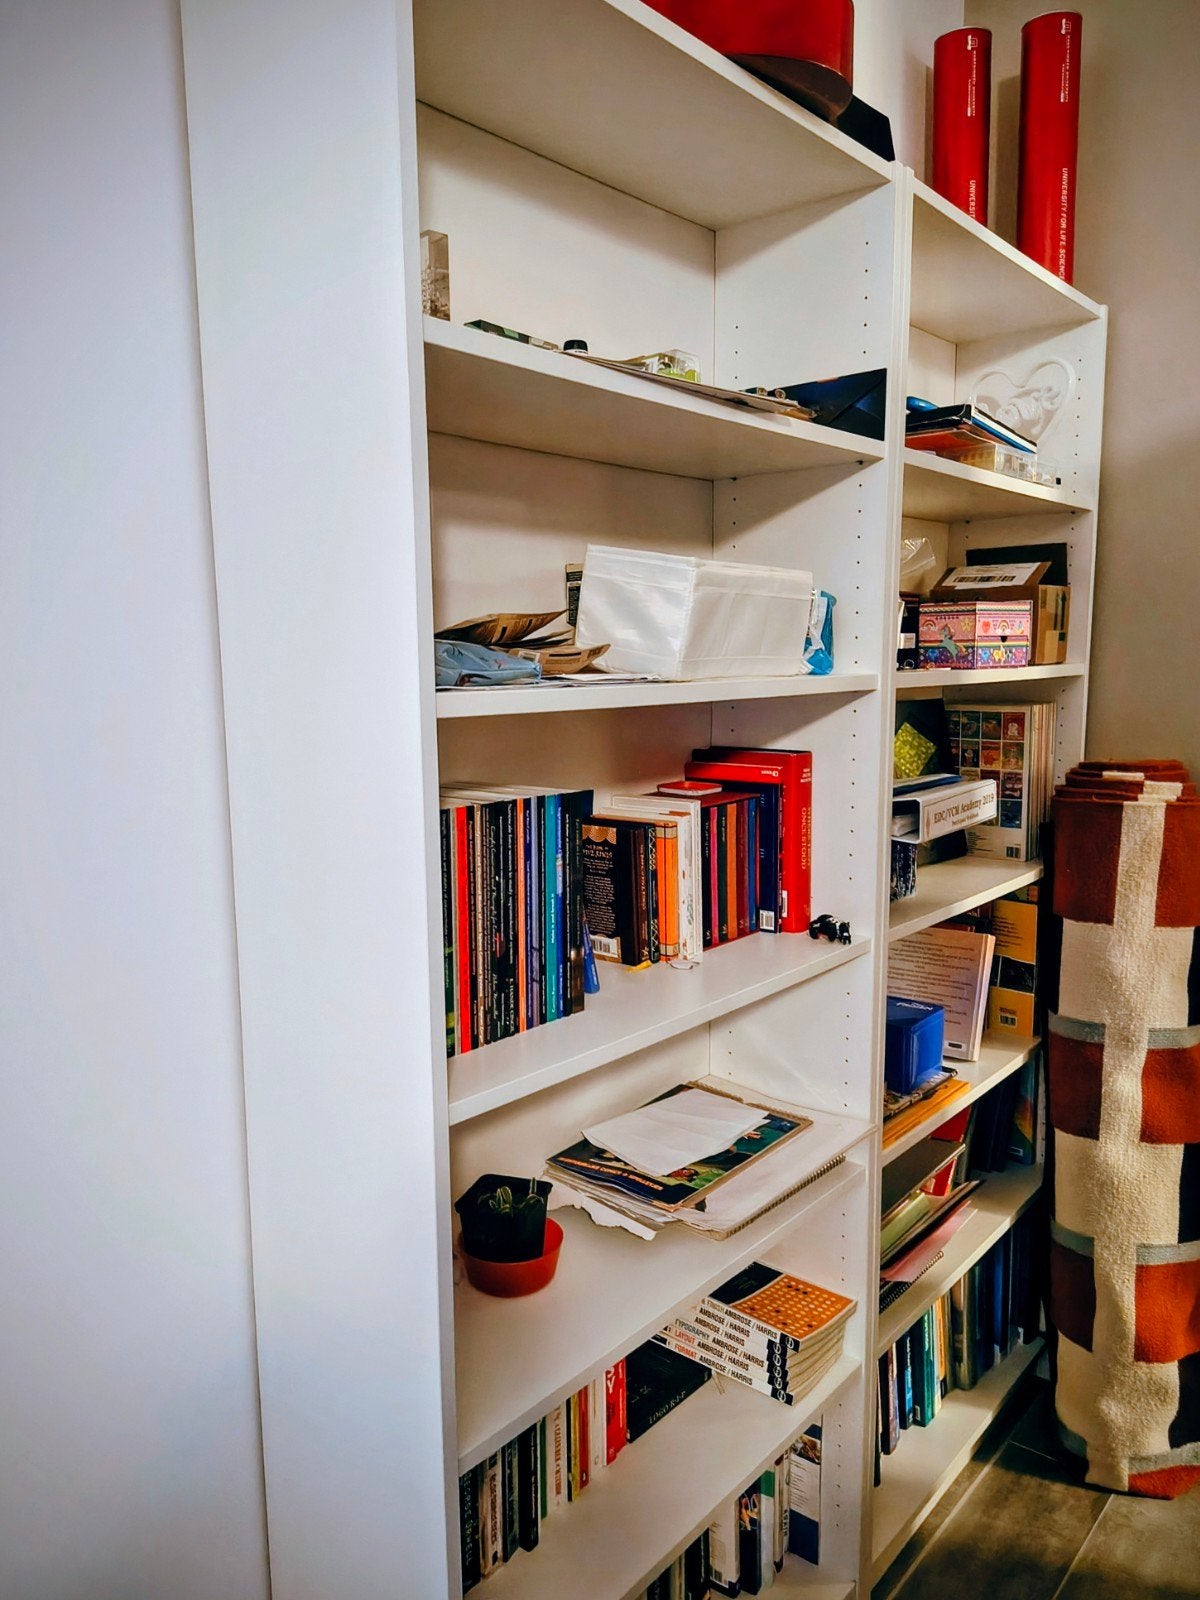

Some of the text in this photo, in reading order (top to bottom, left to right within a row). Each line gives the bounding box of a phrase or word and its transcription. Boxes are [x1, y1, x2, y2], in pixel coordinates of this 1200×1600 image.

[982, 792, 995, 805] 2019
[695, 1317, 720, 1334] AMBROSE
[724, 1330, 745, 1346] HARRIS
[699, 1307, 726, 1325] AMBROSE
[729, 1321, 750, 1337] HARRIS
[725, 1307, 752, 1327] AMBROSE
[756, 1323, 778, 1339] HARRIS
[675, 1319, 710, 1340] TYPOGRAPHY
[712, 1337, 739, 1356] AMBROSE
[743, 1352, 765, 1368] HARRIS
[675, 1329, 695, 1344] LAYOUT
[697, 1341, 724, 1359] AMBROSE
[728, 1355, 749, 1371] HARRIS
[674, 1344, 697, 1359] FORMAT
[699, 1355, 727, 1372] AMBROSE
[731, 1369, 753, 1385] HARRIS
[648, 1404, 669, 1424] LOGO
[464, 1472, 474, 1566] GEORGE ORWELL
